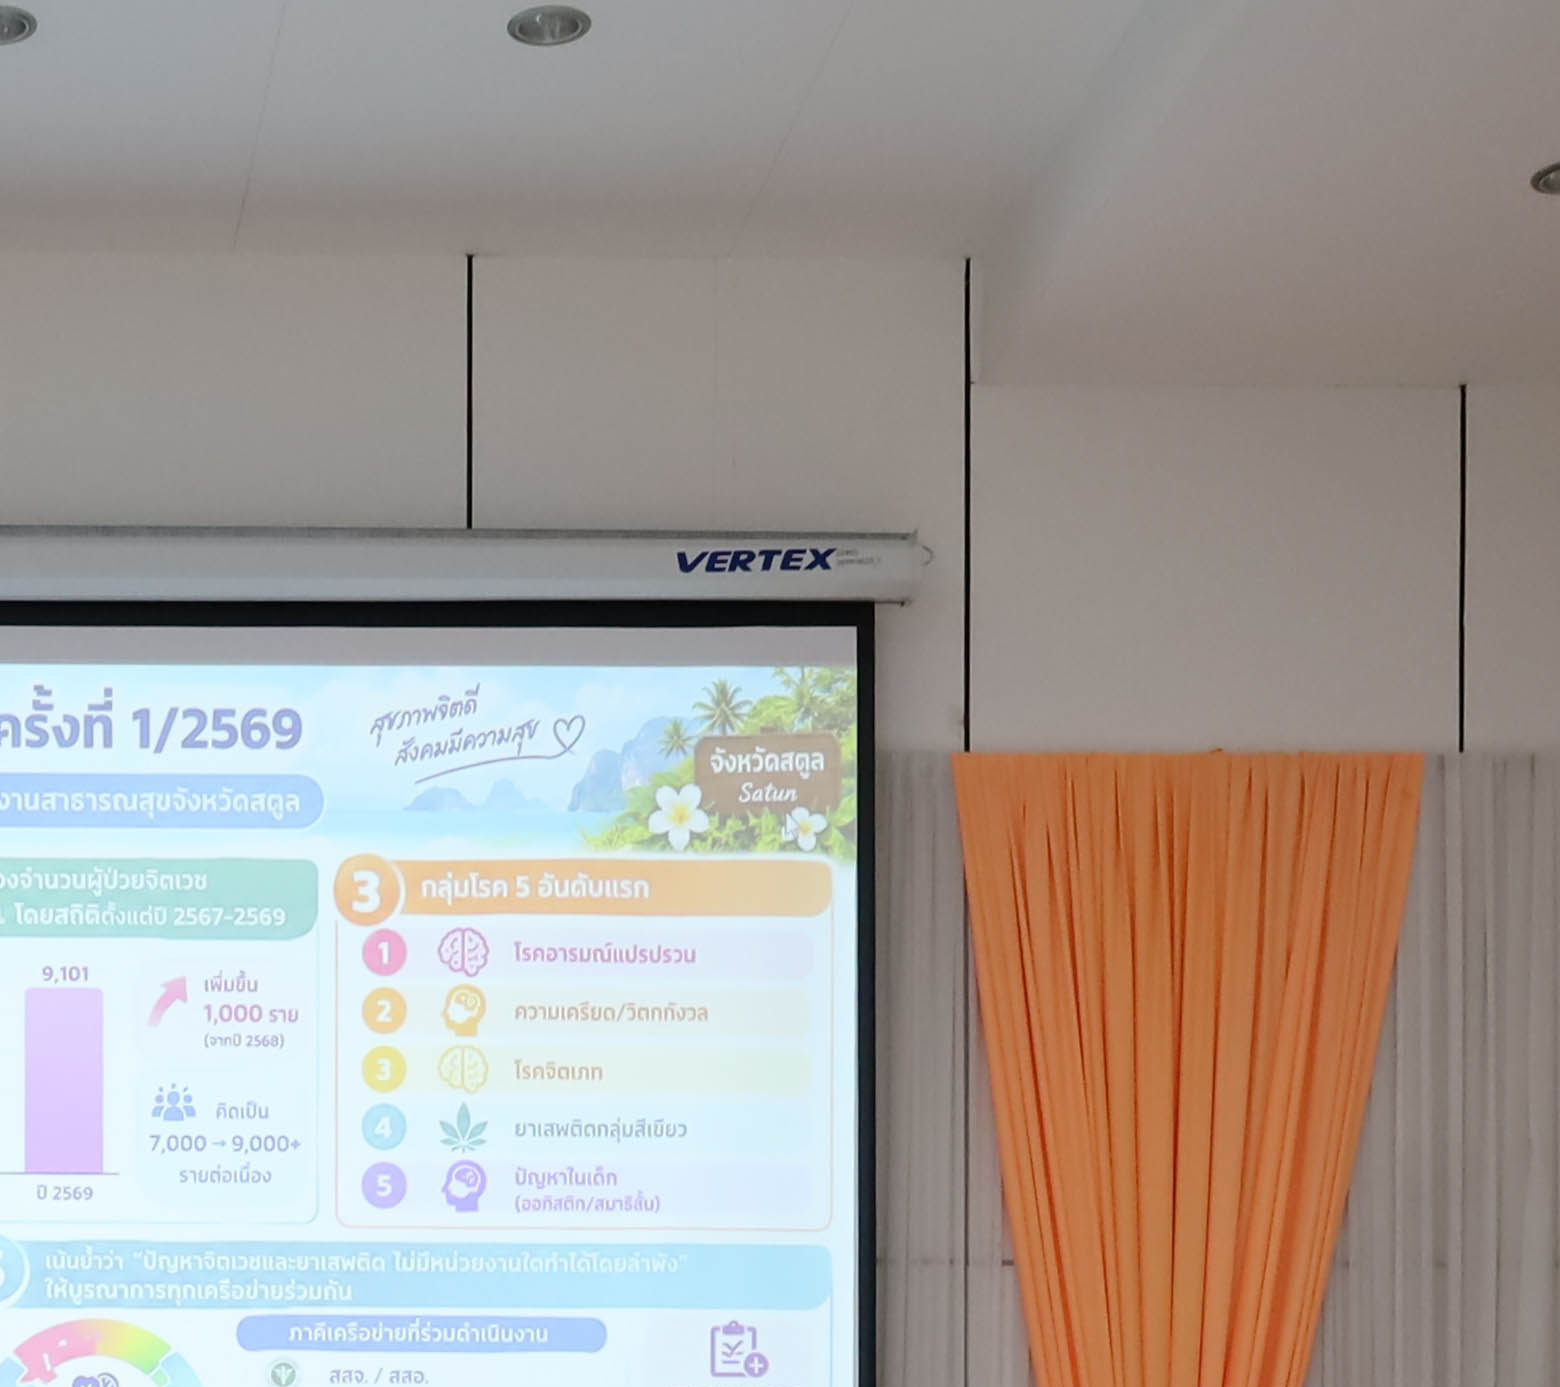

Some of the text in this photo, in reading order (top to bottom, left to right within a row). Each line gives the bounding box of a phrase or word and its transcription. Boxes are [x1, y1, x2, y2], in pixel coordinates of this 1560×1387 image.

[677, 548, 837, 573] VERTEX
[131, 707, 304, 754] 1/2569
[710, 746, 825, 779] จังหวัดสตูล
[738, 781, 799, 803] Satun
[352, 870, 380, 912] 3
[421, 873, 650, 906] กลุ่มโรค 5 อันดับแรก
[173, 906, 286, 927] 2567-2569
[378, 942, 391, 964] 1
[514, 940, 697, 964] โรคอารมณ์แปรปรวน
[41, 965, 90, 984] 9,101
[204, 971, 259, 994] เพิ่มขึ้น
[204, 1004, 299, 1027] 1,000 ราย
[377, 1001, 392, 1023] 2
[377, 1059, 392, 1081] 3
[514, 1058, 603, 1082] โรคจิตเภท
[216, 1100, 270, 1121] คิดเป็น
[374, 1116, 392, 1138] 4
[514, 1115, 688, 1144] ยาเสพติดกลุ่มสีเขียว
[149, 1134, 207, 1155] 7,000
[179, 1163, 272, 1185] รายต่อเนื่อง
[514, 1166, 618, 1190] ปัญหาในเด็ก
[36, 1182, 94, 1201] ปี 2569
[377, 1175, 392, 1197] 5
[44, 1278, 353, 1306] ให้บูรณาการทุกเครือข่ายร่วมกัน
[289, 1316, 549, 1344] ภาคีเครือข่ายที่ร่วมดำเนินงาน
[328, 1367, 368, 1385] สสจ.
[388, 1367, 430, 1385] สสอ.
